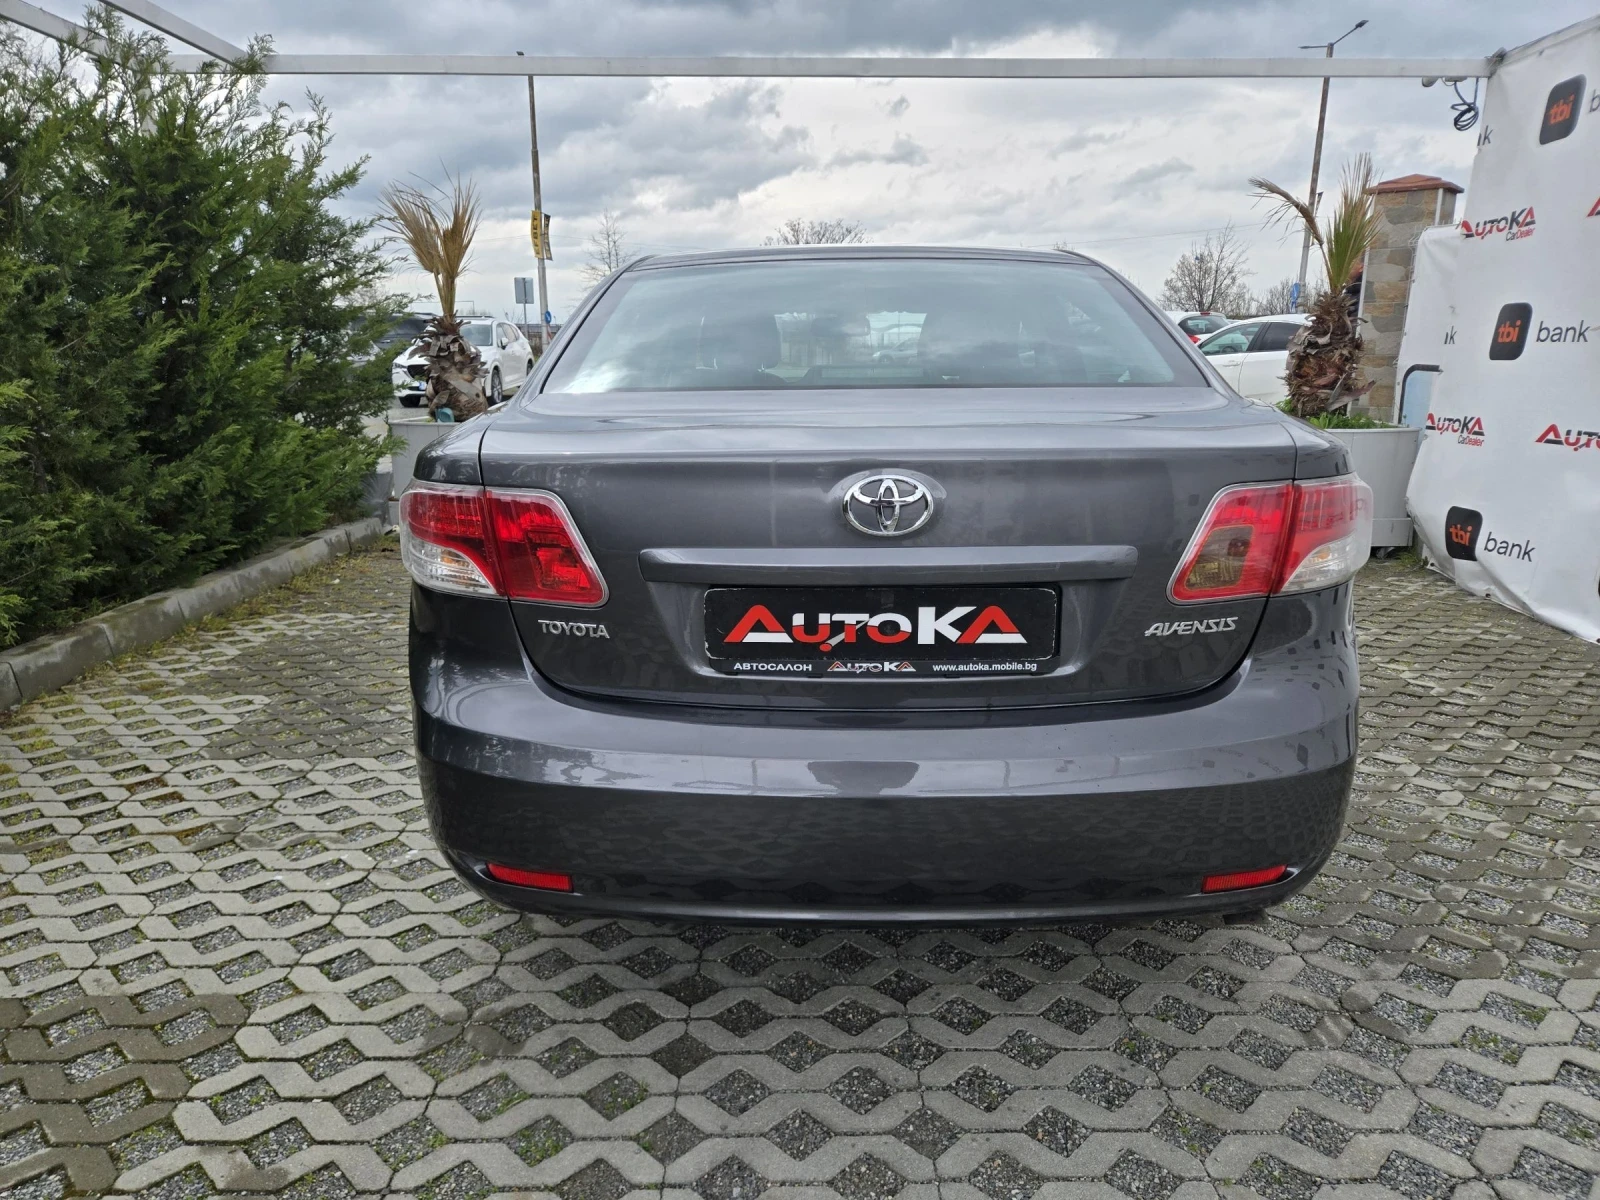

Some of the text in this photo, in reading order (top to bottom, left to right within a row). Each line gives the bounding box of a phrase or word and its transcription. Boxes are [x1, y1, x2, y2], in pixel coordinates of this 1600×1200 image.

[1548, 94, 1575, 125] tbi
[1497, 319, 1590, 343] tbi bank
[1534, 423, 1600, 451] AUT
[1449, 524, 1536, 562] tbi bank
[537, 619, 610, 639] TOYOTA
[723, 604, 1028, 651] AUTOKA
[1144, 616, 1239, 637] AVENSIS
[733, 662, 812, 672] АВТОСАЛОН
[932, 661, 1038, 673] www.autoka.mobile.bg
